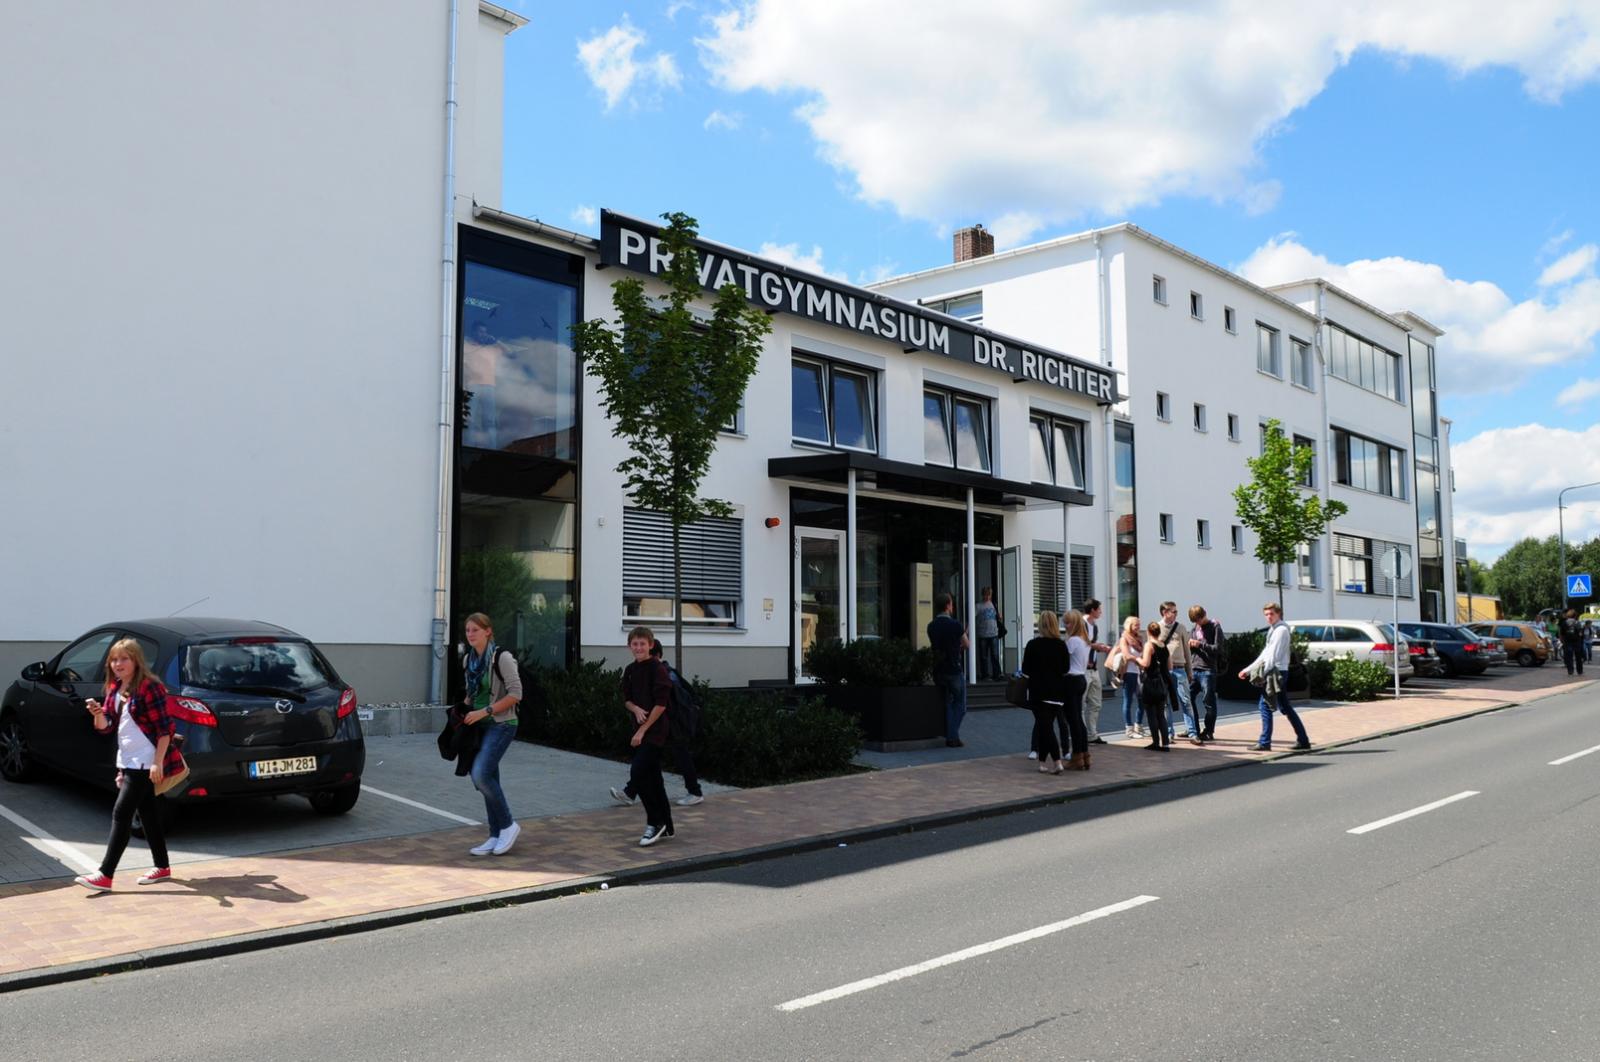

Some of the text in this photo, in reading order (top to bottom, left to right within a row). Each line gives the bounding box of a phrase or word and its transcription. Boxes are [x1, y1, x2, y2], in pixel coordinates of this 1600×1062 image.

[620, 228, 1112, 401] PRVATGYMNASIUM DR. RICHTER
[295, 757, 315, 770] 281
